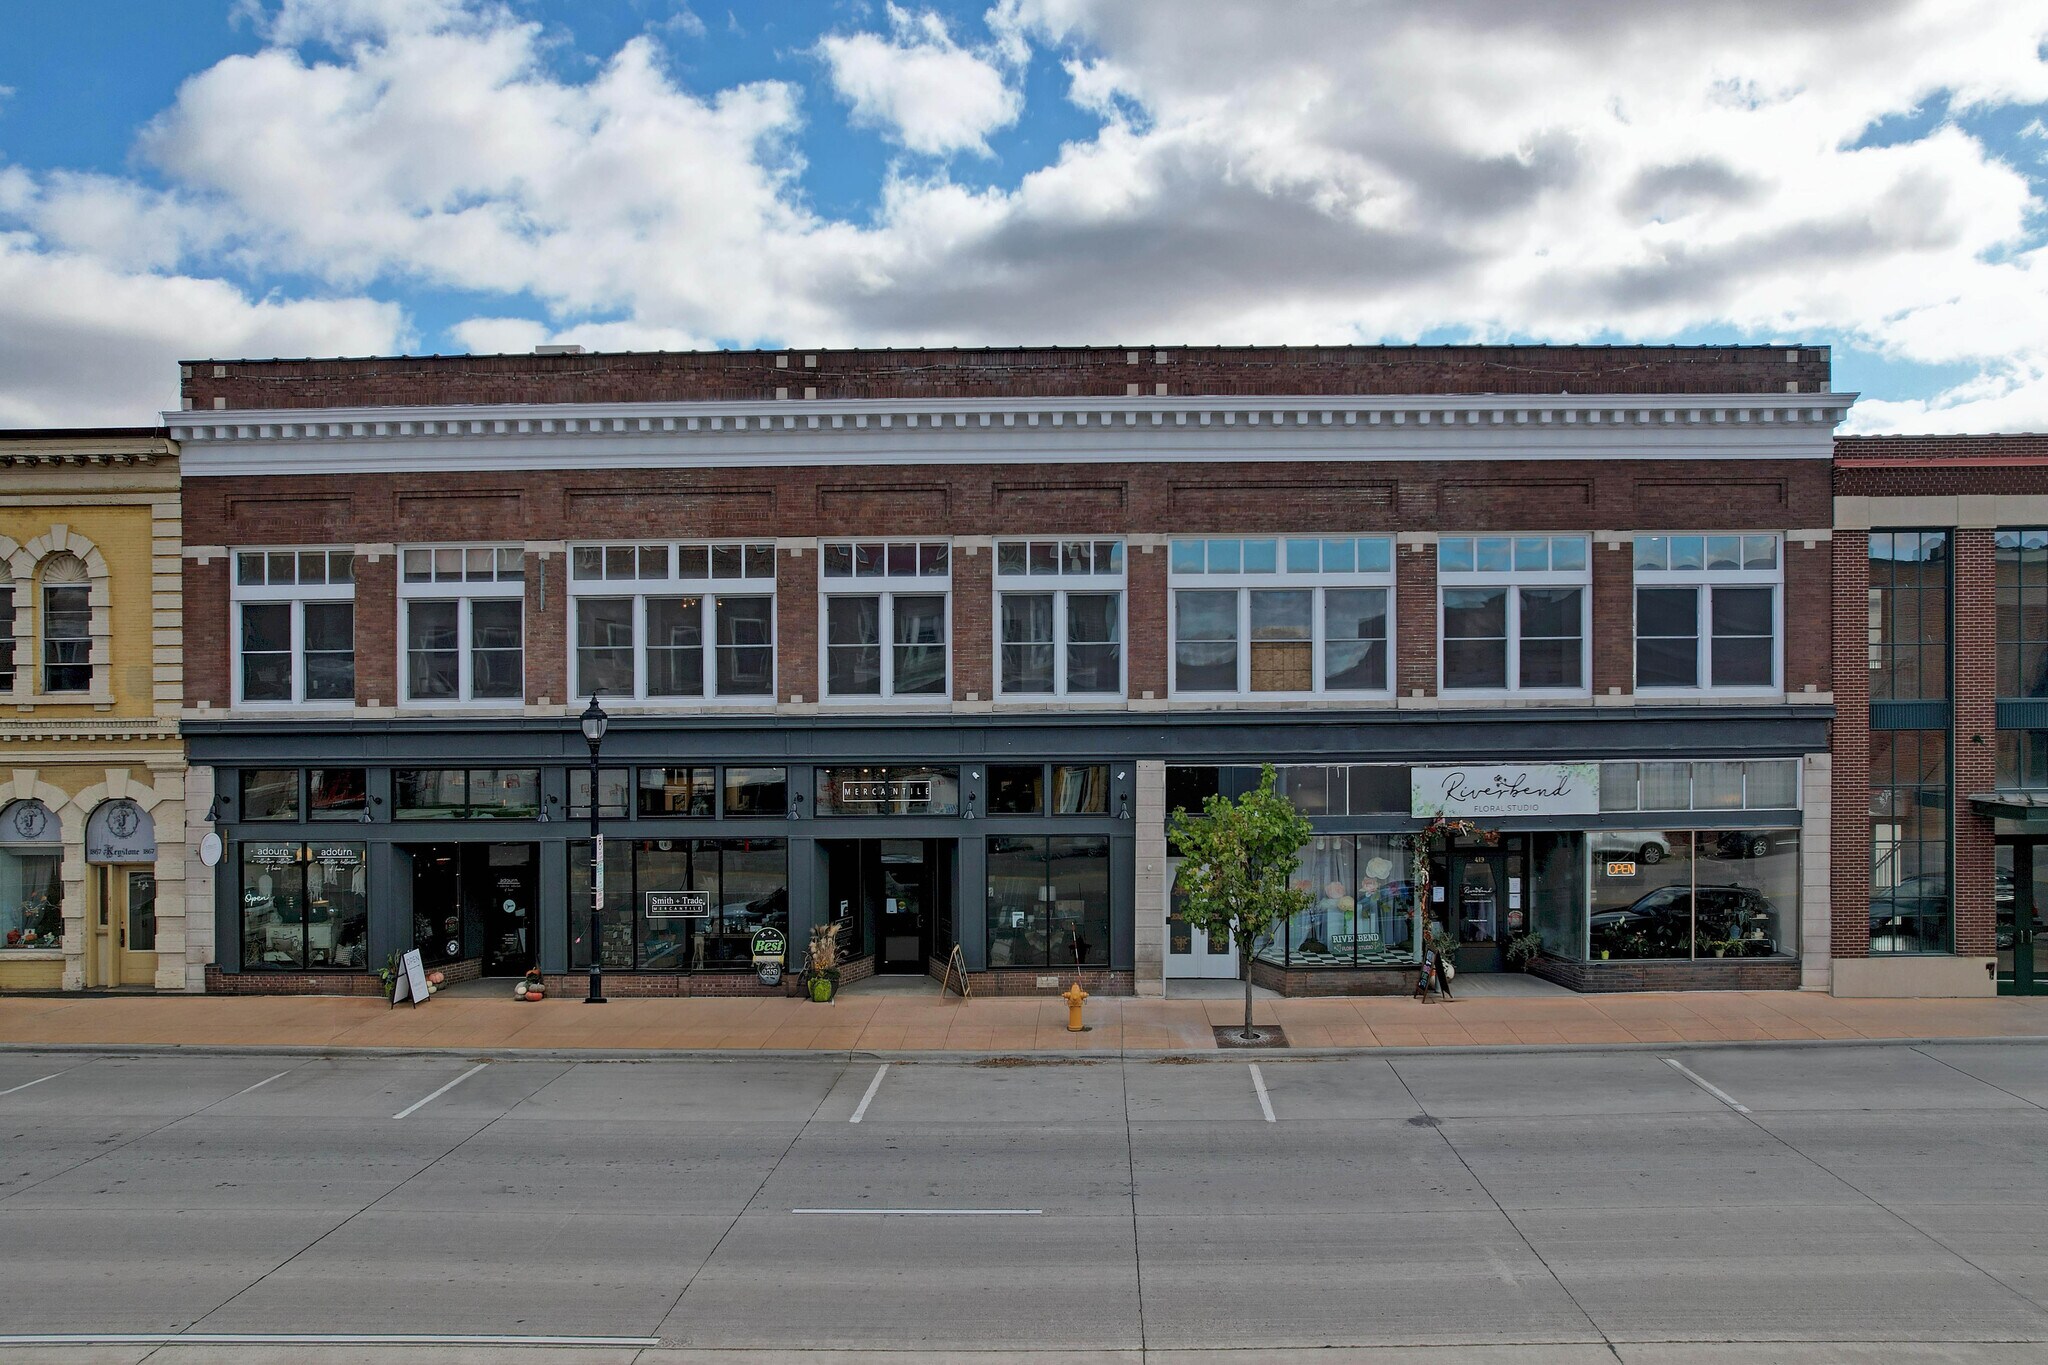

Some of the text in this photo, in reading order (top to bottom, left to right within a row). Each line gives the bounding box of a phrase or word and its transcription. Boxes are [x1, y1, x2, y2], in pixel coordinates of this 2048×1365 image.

[844, 787, 929, 796] MERCANTILE
[1441, 772, 1572, 802] Riverbend
[1474, 804, 1539, 813] FLORAL STUDIO
[257, 847, 289, 856] adourn
[321, 848, 353, 856] adourn
[1609, 863, 1634, 875] OPEN
[244, 892, 270, 906] Open
[652, 896, 674, 904] Smith
[1332, 933, 1380, 943] RIVEBEND
[754, 940, 784, 951] Best
